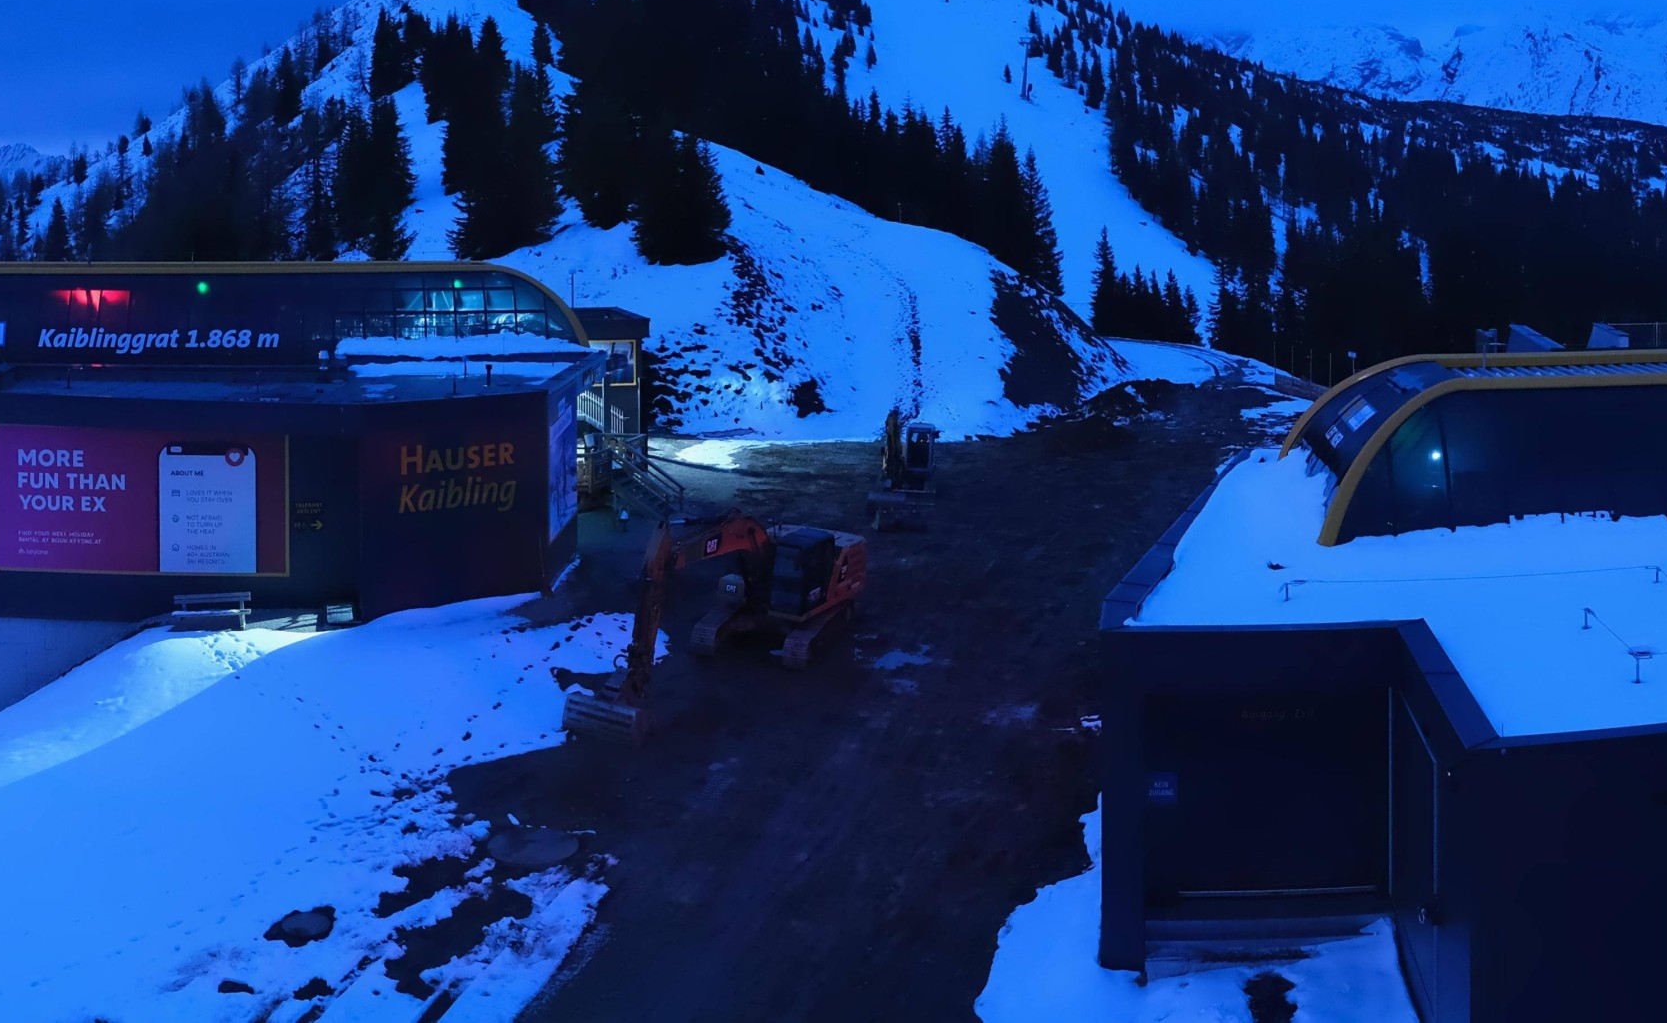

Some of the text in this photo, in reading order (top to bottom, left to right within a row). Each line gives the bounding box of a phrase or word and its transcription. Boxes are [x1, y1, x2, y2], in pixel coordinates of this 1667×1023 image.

[38, 328, 280, 354] Kaiblinggrat 1.868 m
[17, 449, 85, 467] MORE
[400, 442, 515, 475] HAUSER
[17, 472, 126, 490] FUN THAN
[19, 495, 106, 512] YOUR EX
[398, 476, 517, 513] Kaibling
[706, 538, 719, 554] CAT
[725, 584, 737, 593] CAT
